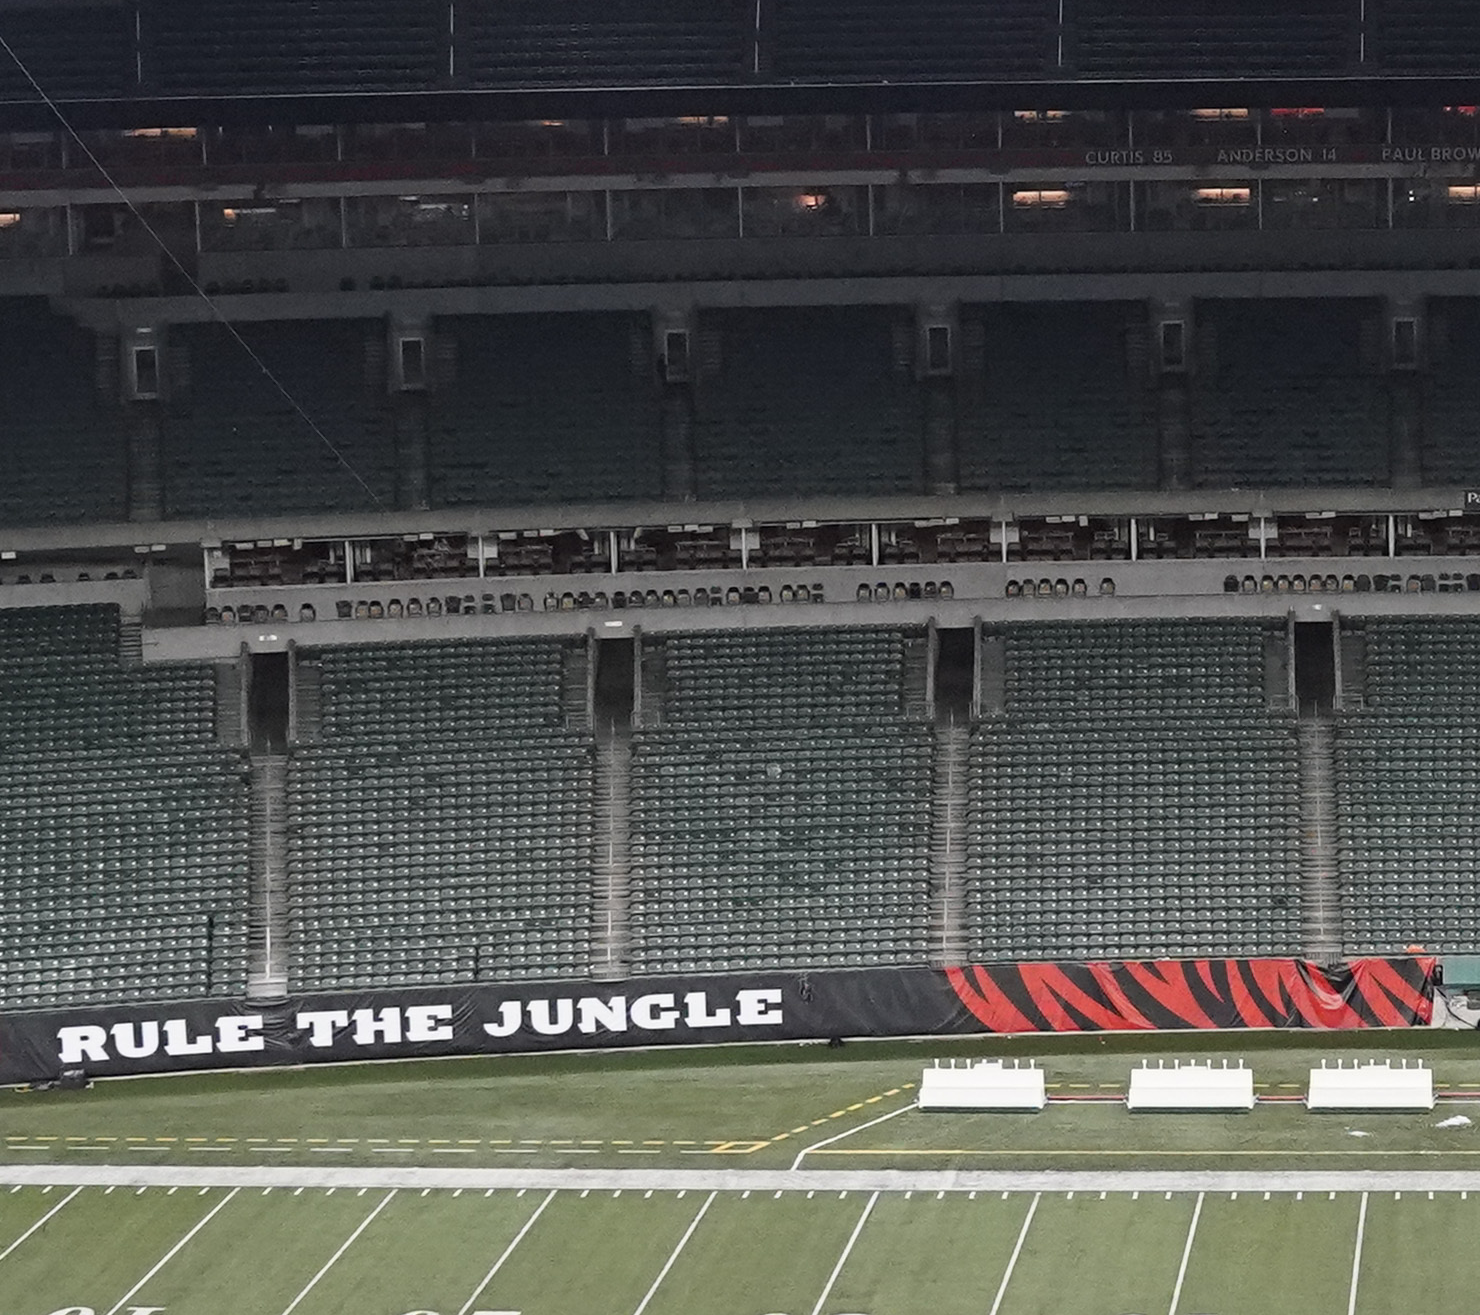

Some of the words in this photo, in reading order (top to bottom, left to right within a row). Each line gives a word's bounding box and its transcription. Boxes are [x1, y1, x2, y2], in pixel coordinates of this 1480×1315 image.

[1085, 150, 1144, 165] CURTIS
[1153, 150, 1173, 164] 85
[1217, 148, 1313, 164] ANDERSON
[1322, 148, 1337, 161] 14
[1381, 147, 1425, 161] PAUL
[57, 1015, 264, 1064] RULE
[297, 1005, 453, 1048] THE
[484, 989, 783, 1037] JUNGLE
